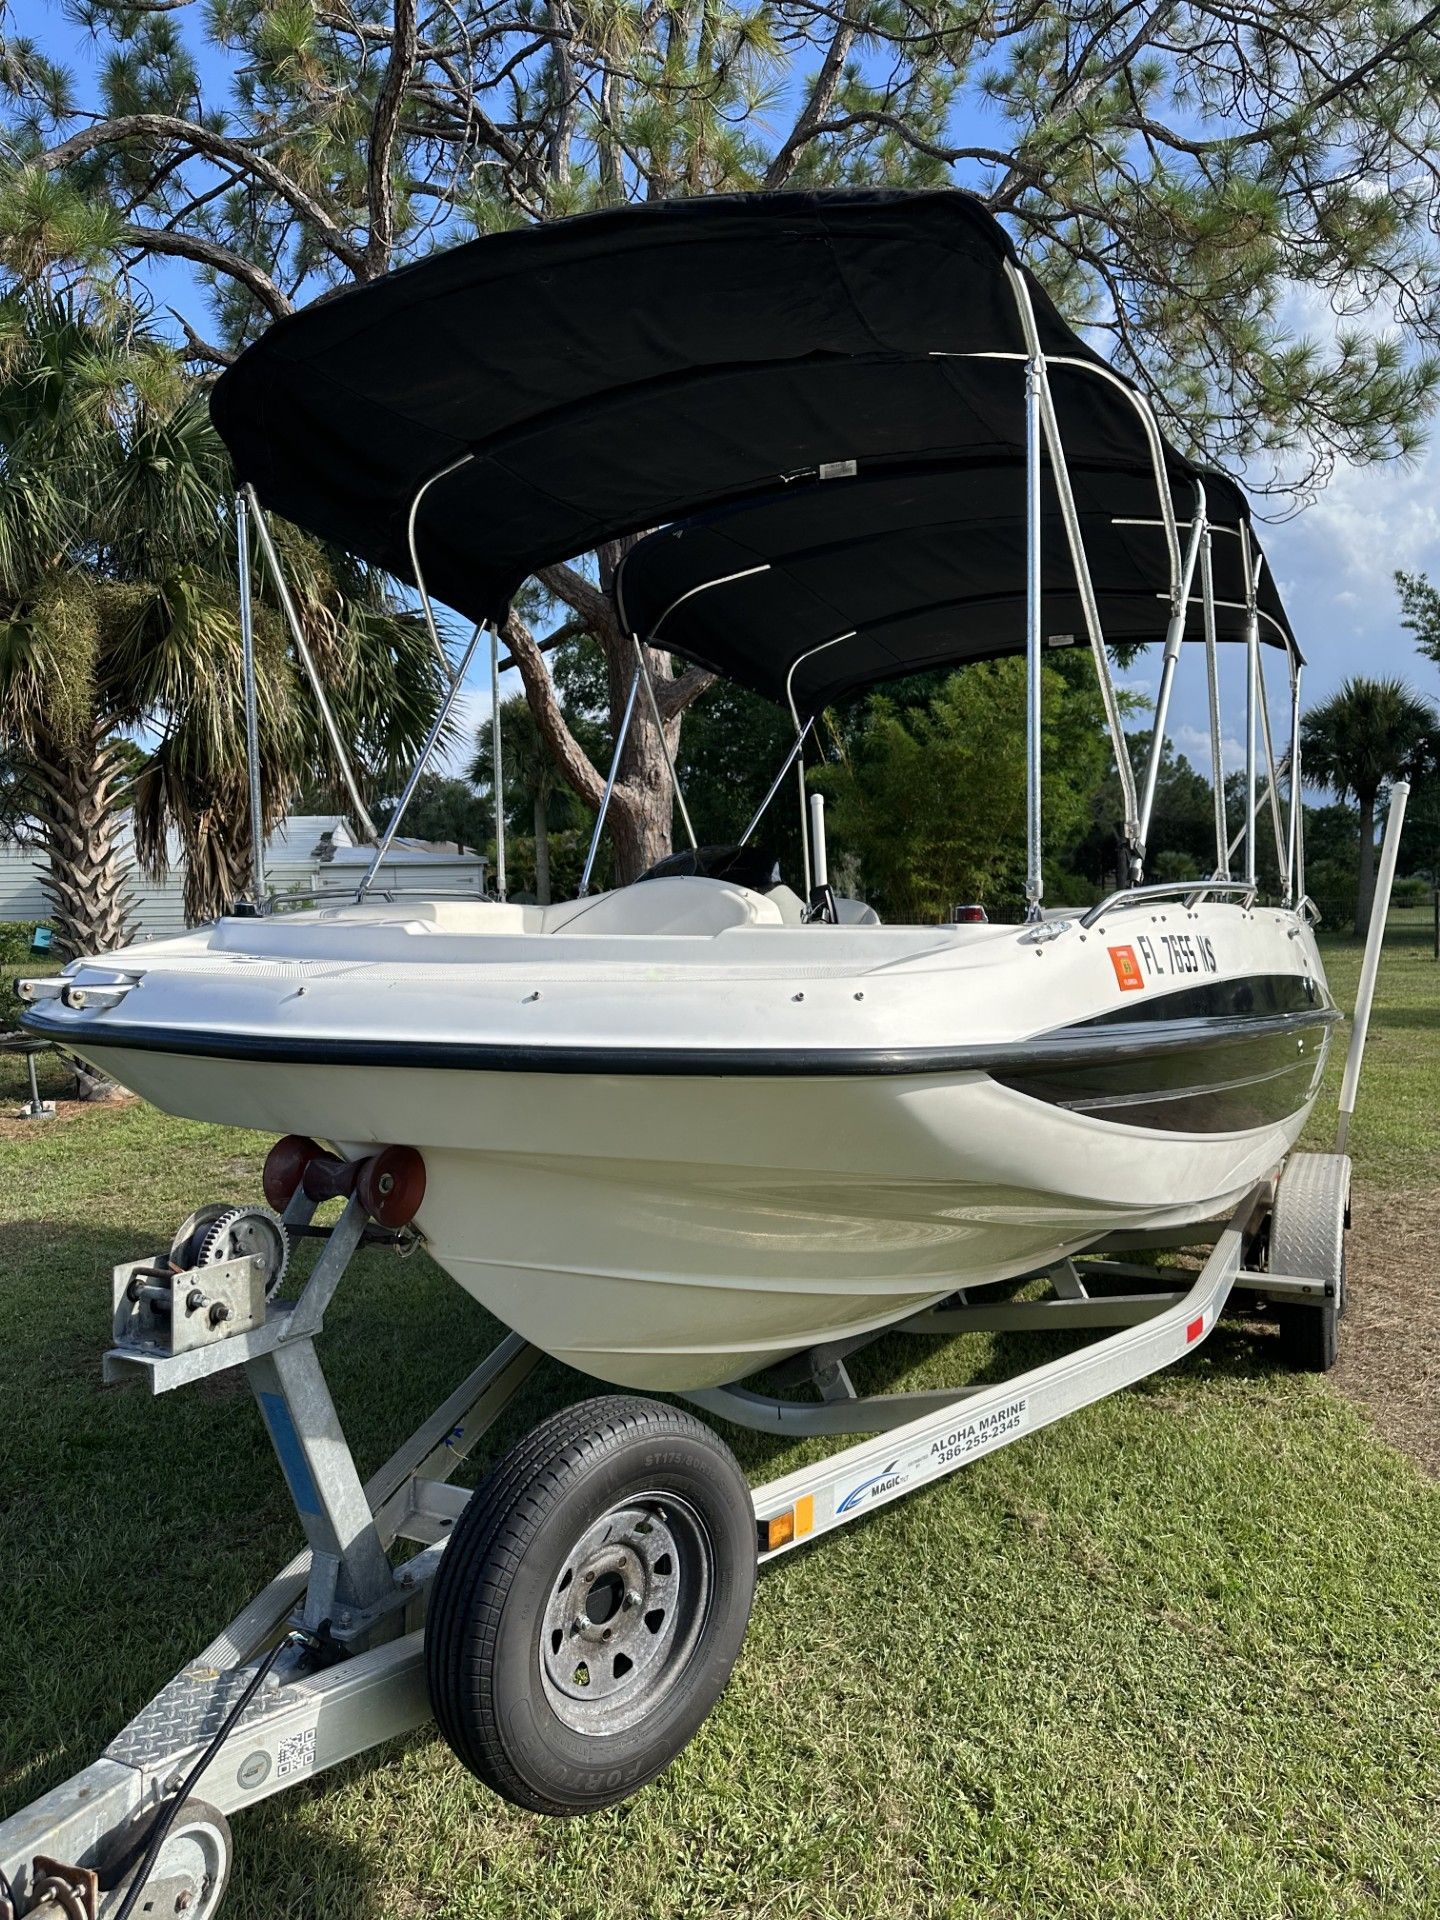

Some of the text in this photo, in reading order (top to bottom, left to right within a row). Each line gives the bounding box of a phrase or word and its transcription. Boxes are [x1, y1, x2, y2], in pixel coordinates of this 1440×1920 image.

[1137, 936, 1164, 975] FL
[1160, 935, 1198, 975] 7655
[930, 1400, 1026, 1455] ALOHA MARINE
[937, 1416, 1020, 1464] 386-255-2345
